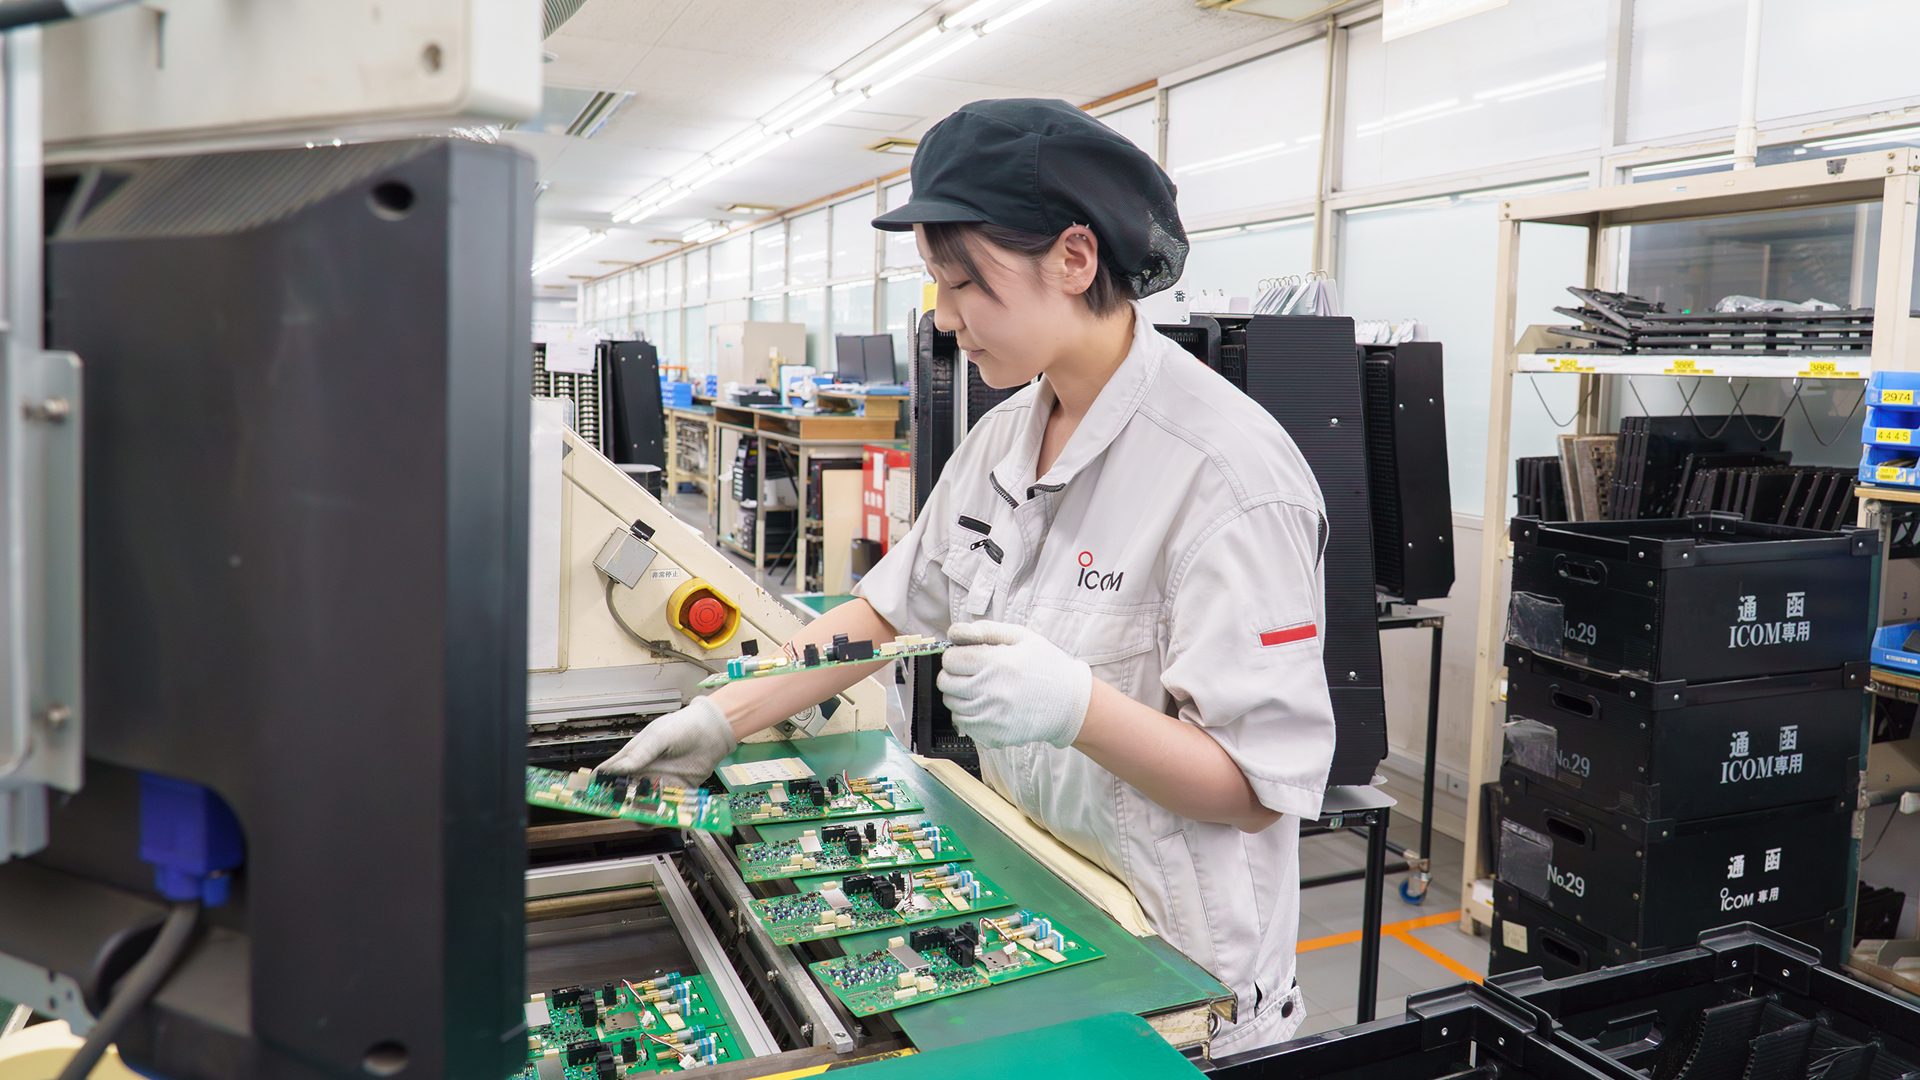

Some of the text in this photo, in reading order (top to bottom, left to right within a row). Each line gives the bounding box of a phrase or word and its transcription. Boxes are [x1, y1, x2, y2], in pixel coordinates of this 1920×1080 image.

[1883, 392, 1911, 401] 2974
[1554, 749, 1590, 778] No.29
[1547, 863, 1585, 897] No.29
